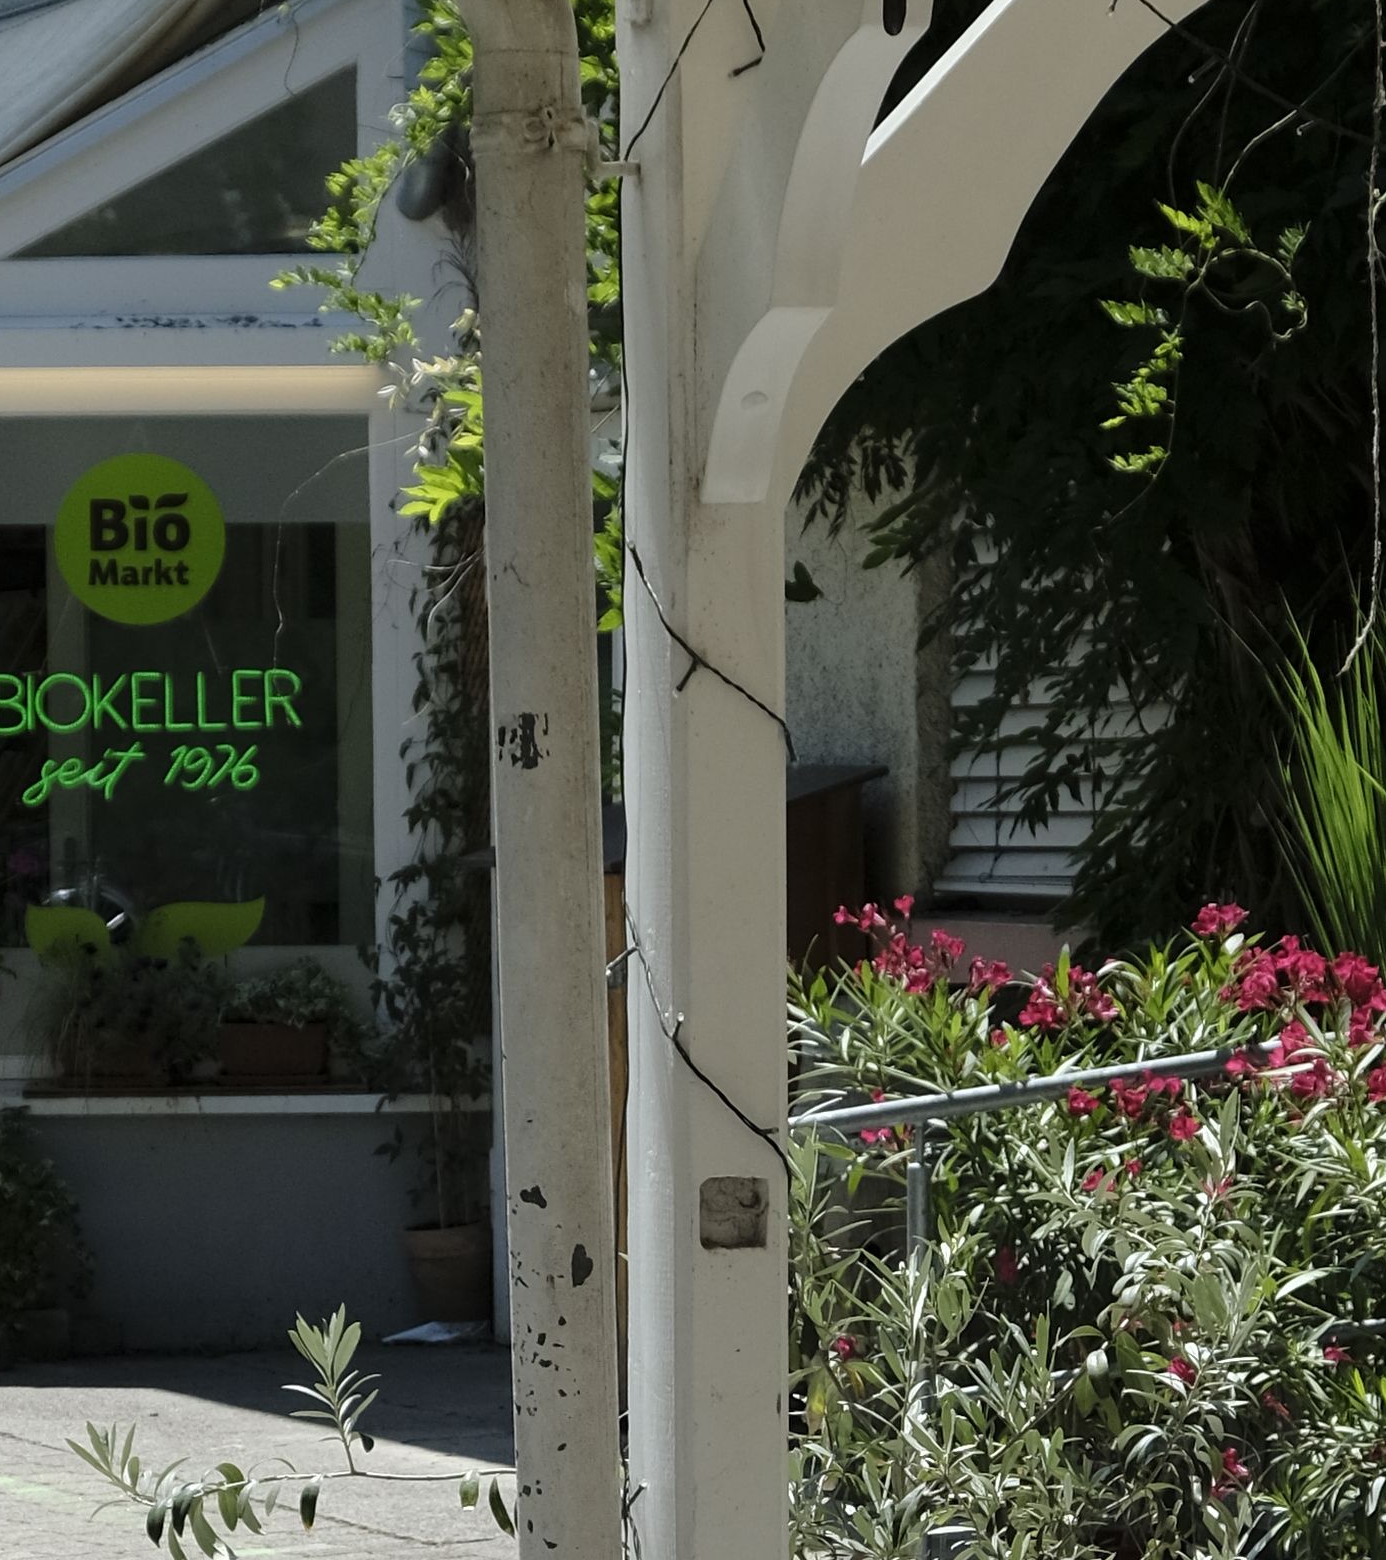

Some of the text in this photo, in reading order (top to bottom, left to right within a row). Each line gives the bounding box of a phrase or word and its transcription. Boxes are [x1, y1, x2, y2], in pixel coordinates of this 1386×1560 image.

[88, 491, 191, 552] Bio
[87, 558, 191, 587] Markt
[21, 741, 261, 808] seit 1976
